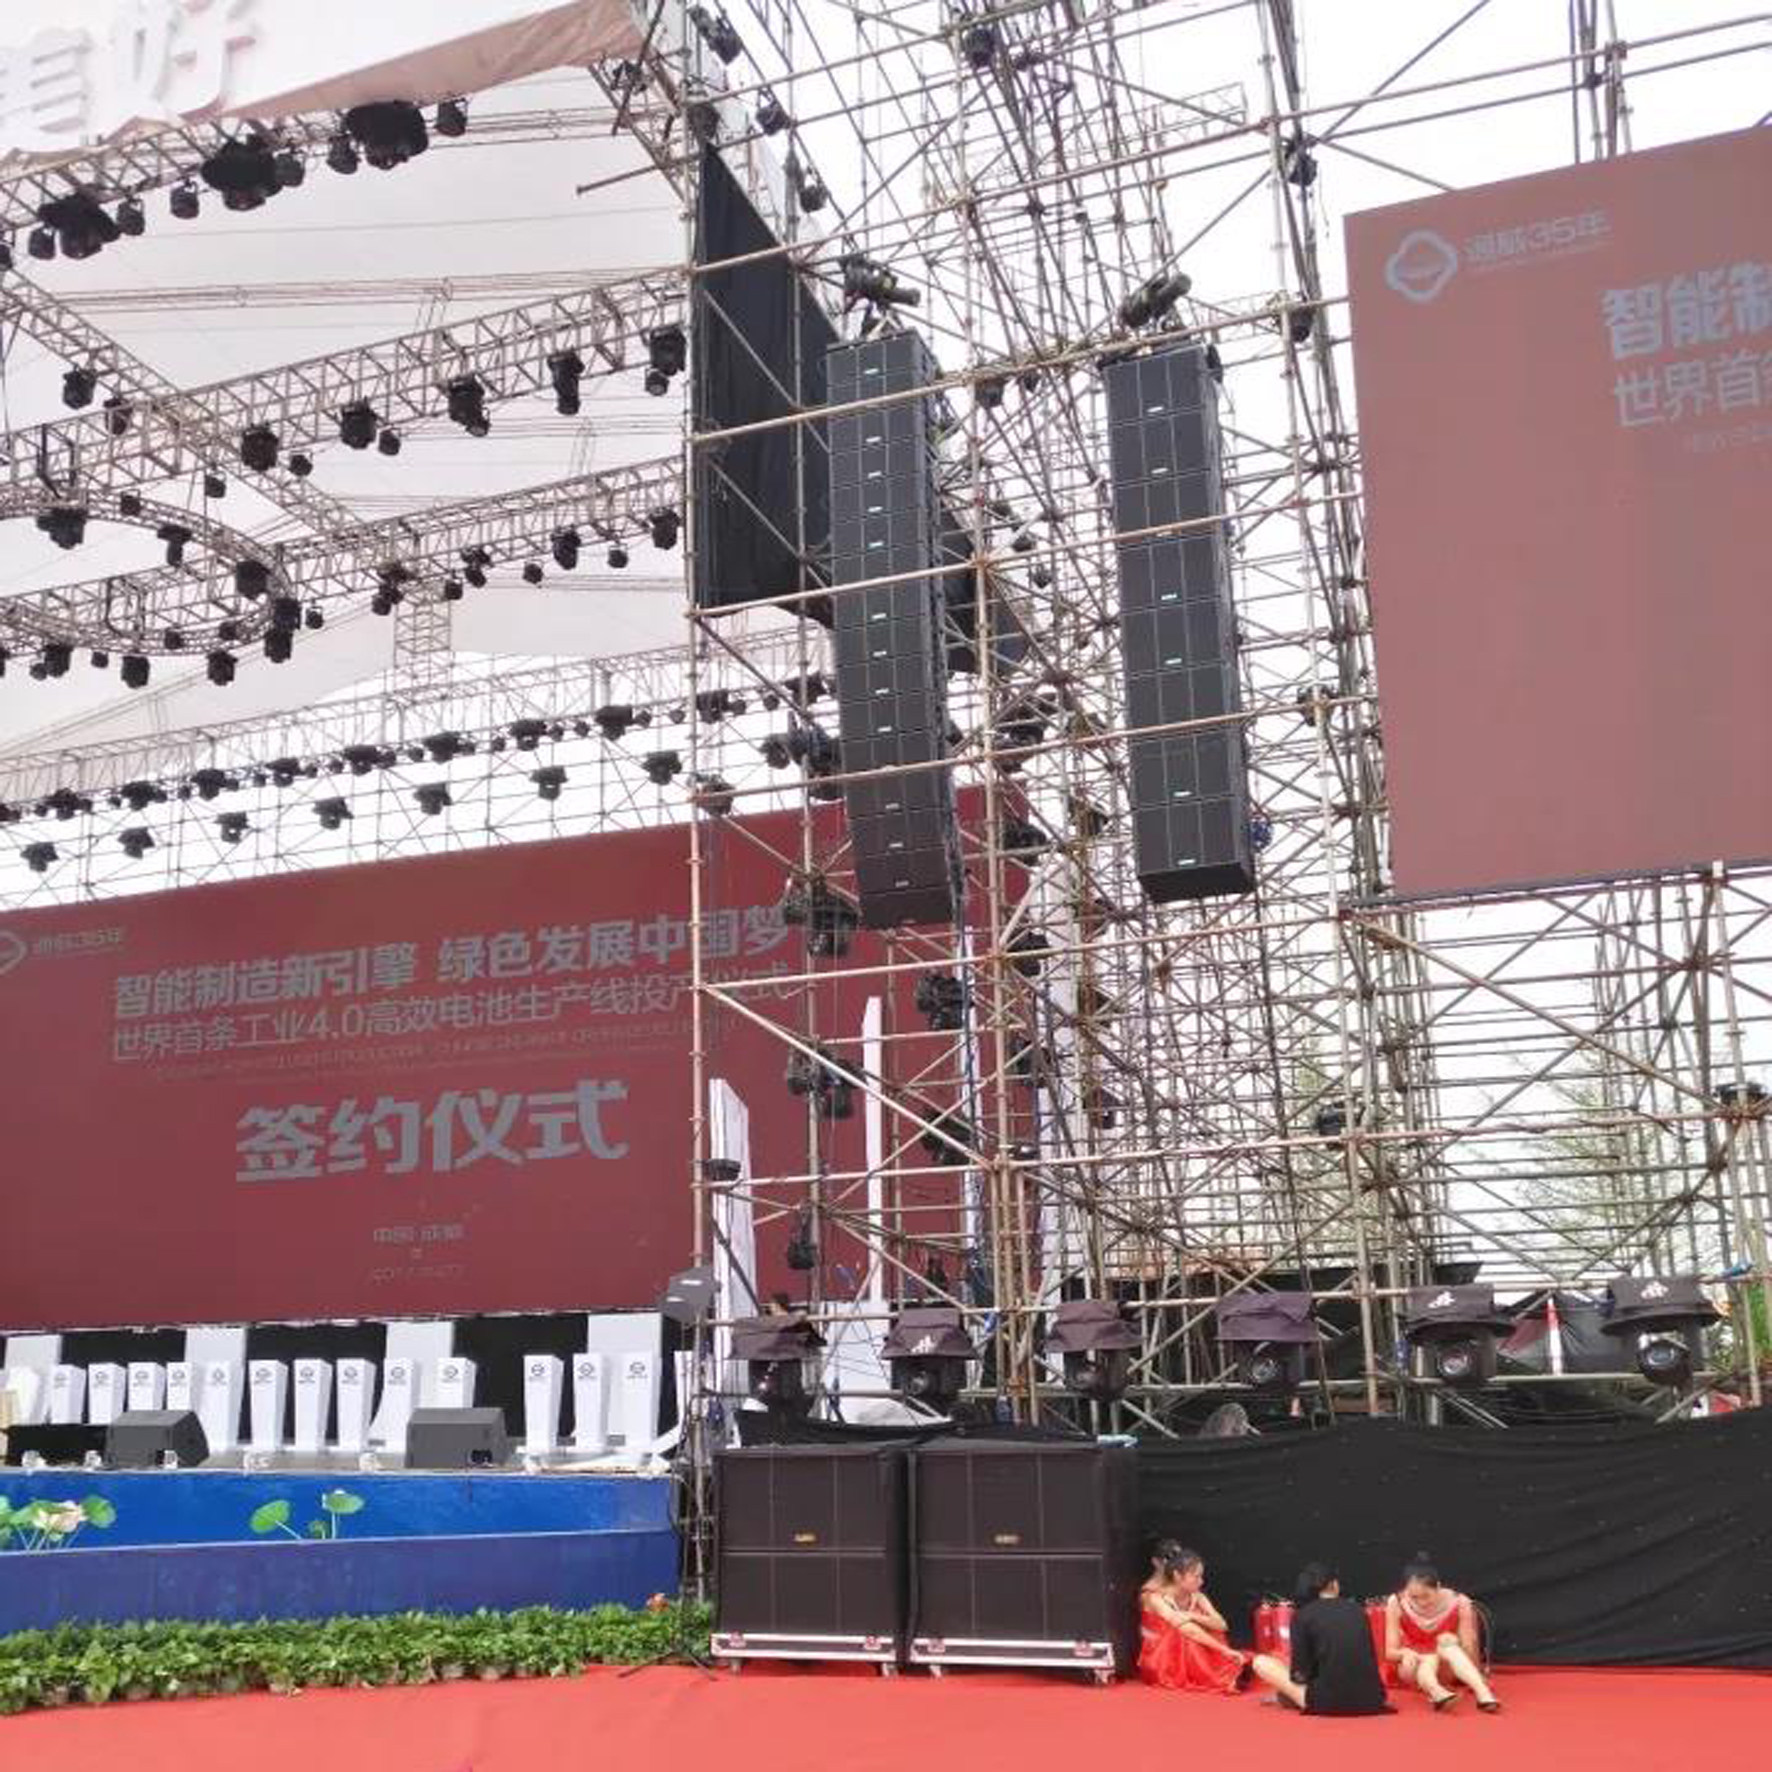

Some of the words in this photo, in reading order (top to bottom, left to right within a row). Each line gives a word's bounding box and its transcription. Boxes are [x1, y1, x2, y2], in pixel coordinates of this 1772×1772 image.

[1612, 347, 1772, 429] 世界首
[112, 960, 793, 1063] 世界首条工业4.0高效电池生产线投产仪式
[113, 940, 420, 1020] 智能制造新引擎
[437, 903, 792, 985] 绿色发展中国梦
[235, 1079, 630, 1183] 签约仪式
